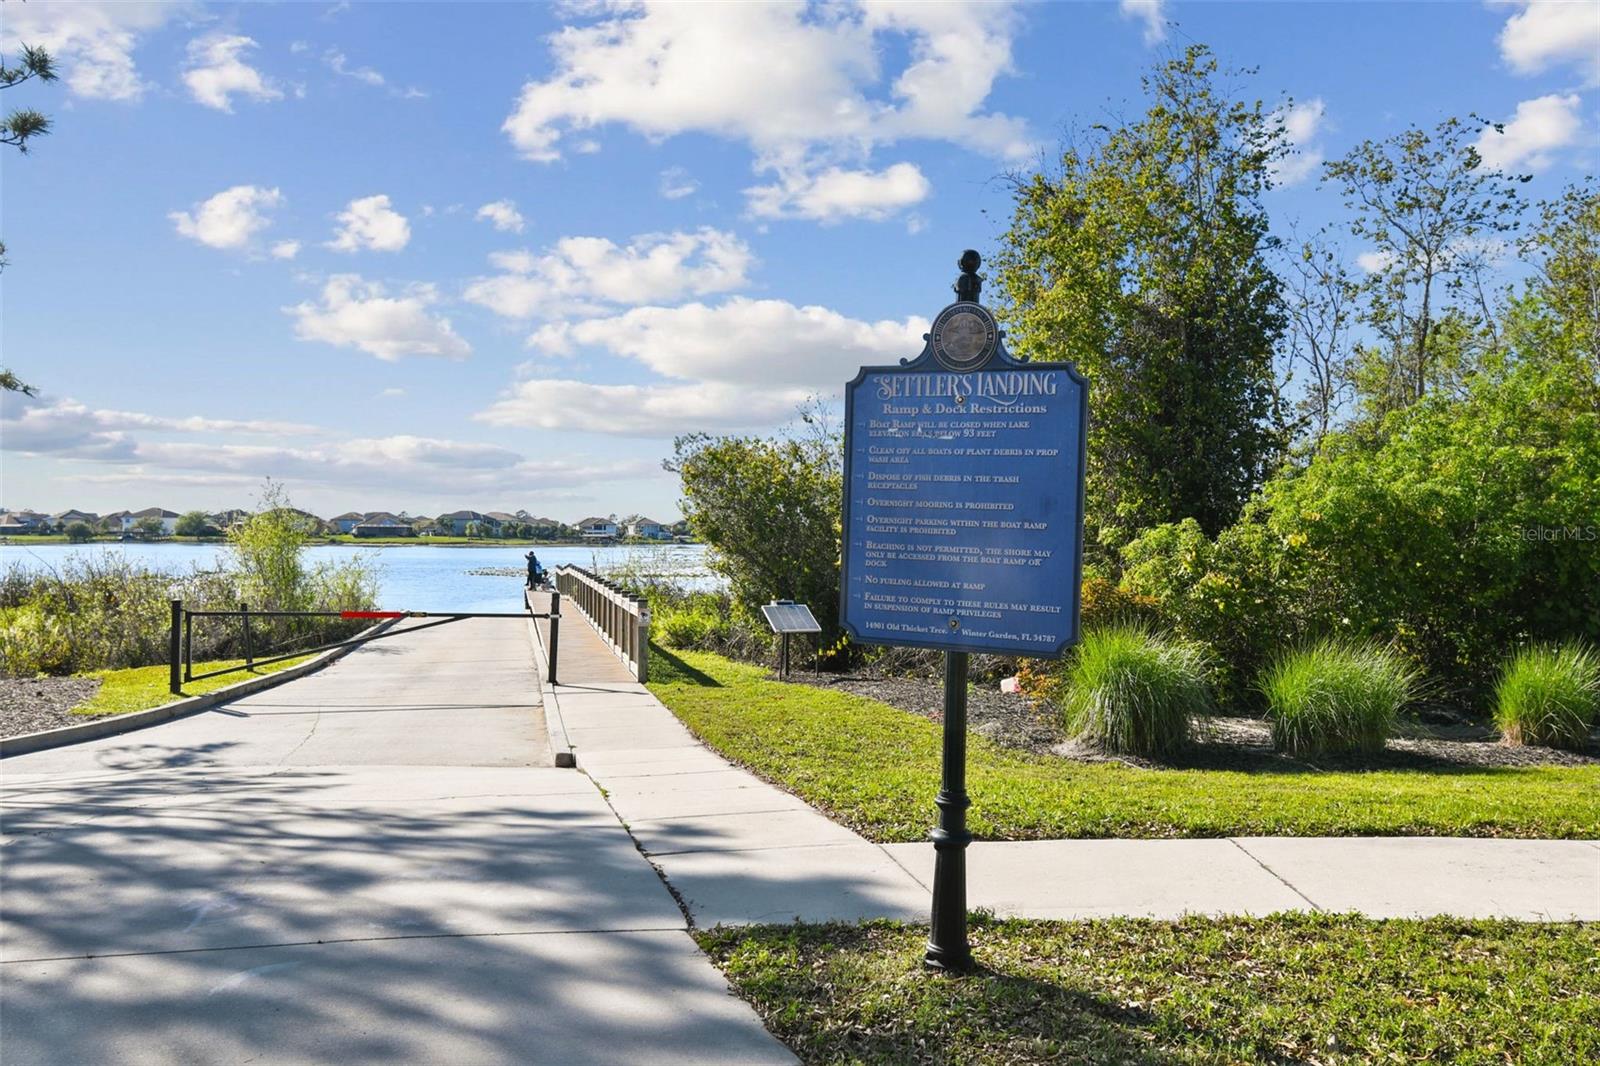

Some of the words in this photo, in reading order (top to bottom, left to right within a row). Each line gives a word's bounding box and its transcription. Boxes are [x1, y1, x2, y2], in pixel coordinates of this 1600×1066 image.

[873, 373, 973, 400] SETTLER'S
[976, 371, 1057, 406] LANDING
[883, 403, 919, 416] Ramp
[922, 404, 932, 414] &
[936, 403, 967, 414] Dock
[970, 403, 1047, 414] Restrictions
[963, 428, 975, 437] 93
[965, 502, 1015, 510] PROHIBITED
[914, 518, 949, 526] PARKING
[1000, 521, 1022, 529] BOAT
[1023, 522, 1047, 530] RAMP
[909, 527, 957, 535] PROHIBITED
[935, 546, 983, 556] PERMITTED,
[1003, 549, 1032, 557] SHORE
[1033, 550, 1052, 558] MAY
[937, 554, 961, 562] FROM
[980, 556, 1002, 564] BOAT
[913, 579, 950, 588] ALLOWED
[951, 581, 961, 589] AT
[963, 582, 986, 590] RAMP
[910, 597, 942, 605] COMPLY
[956, 600, 982, 608] THESE
[983, 601, 1009, 609] RULES
[1010, 603, 1029, 611] MAY
[1030, 604, 1062, 613] RESULT
[932, 607, 955, 615] RAMP
[956, 609, 1002, 618] PRIVILEGES
[886, 622, 900, 631] Old
[901, 625, 929, 633] Thicket
[961, 629, 987, 638] Winter
[988, 631, 1020, 641] Garden,
[1021, 633, 1032, 641] FL
[1033, 634, 1056, 643] 34787
